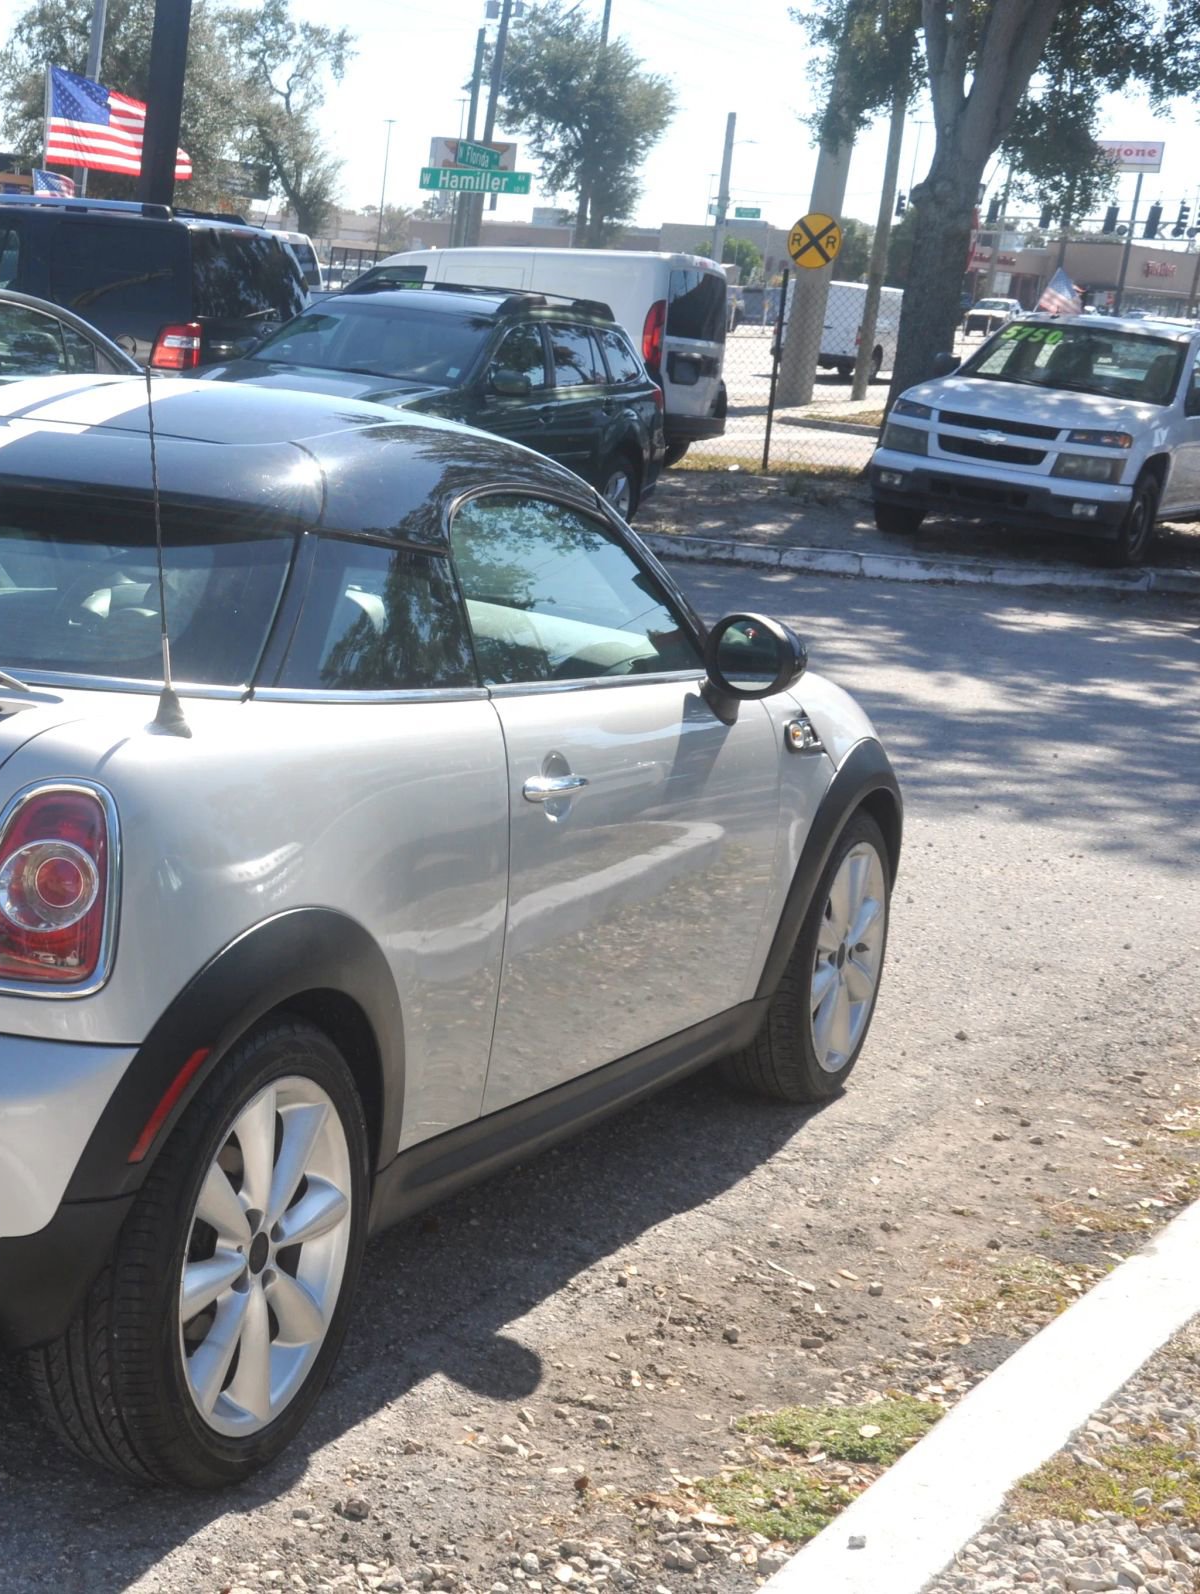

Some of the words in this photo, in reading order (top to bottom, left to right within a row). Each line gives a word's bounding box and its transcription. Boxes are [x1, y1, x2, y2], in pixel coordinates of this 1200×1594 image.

[466, 145, 489, 169] Florida
[422, 172, 432, 185] W
[438, 170, 509, 191] Hamiller
[791, 232, 803, 247] R
[825, 235, 837, 249] R
[1000, 325, 1064, 344] 5750
